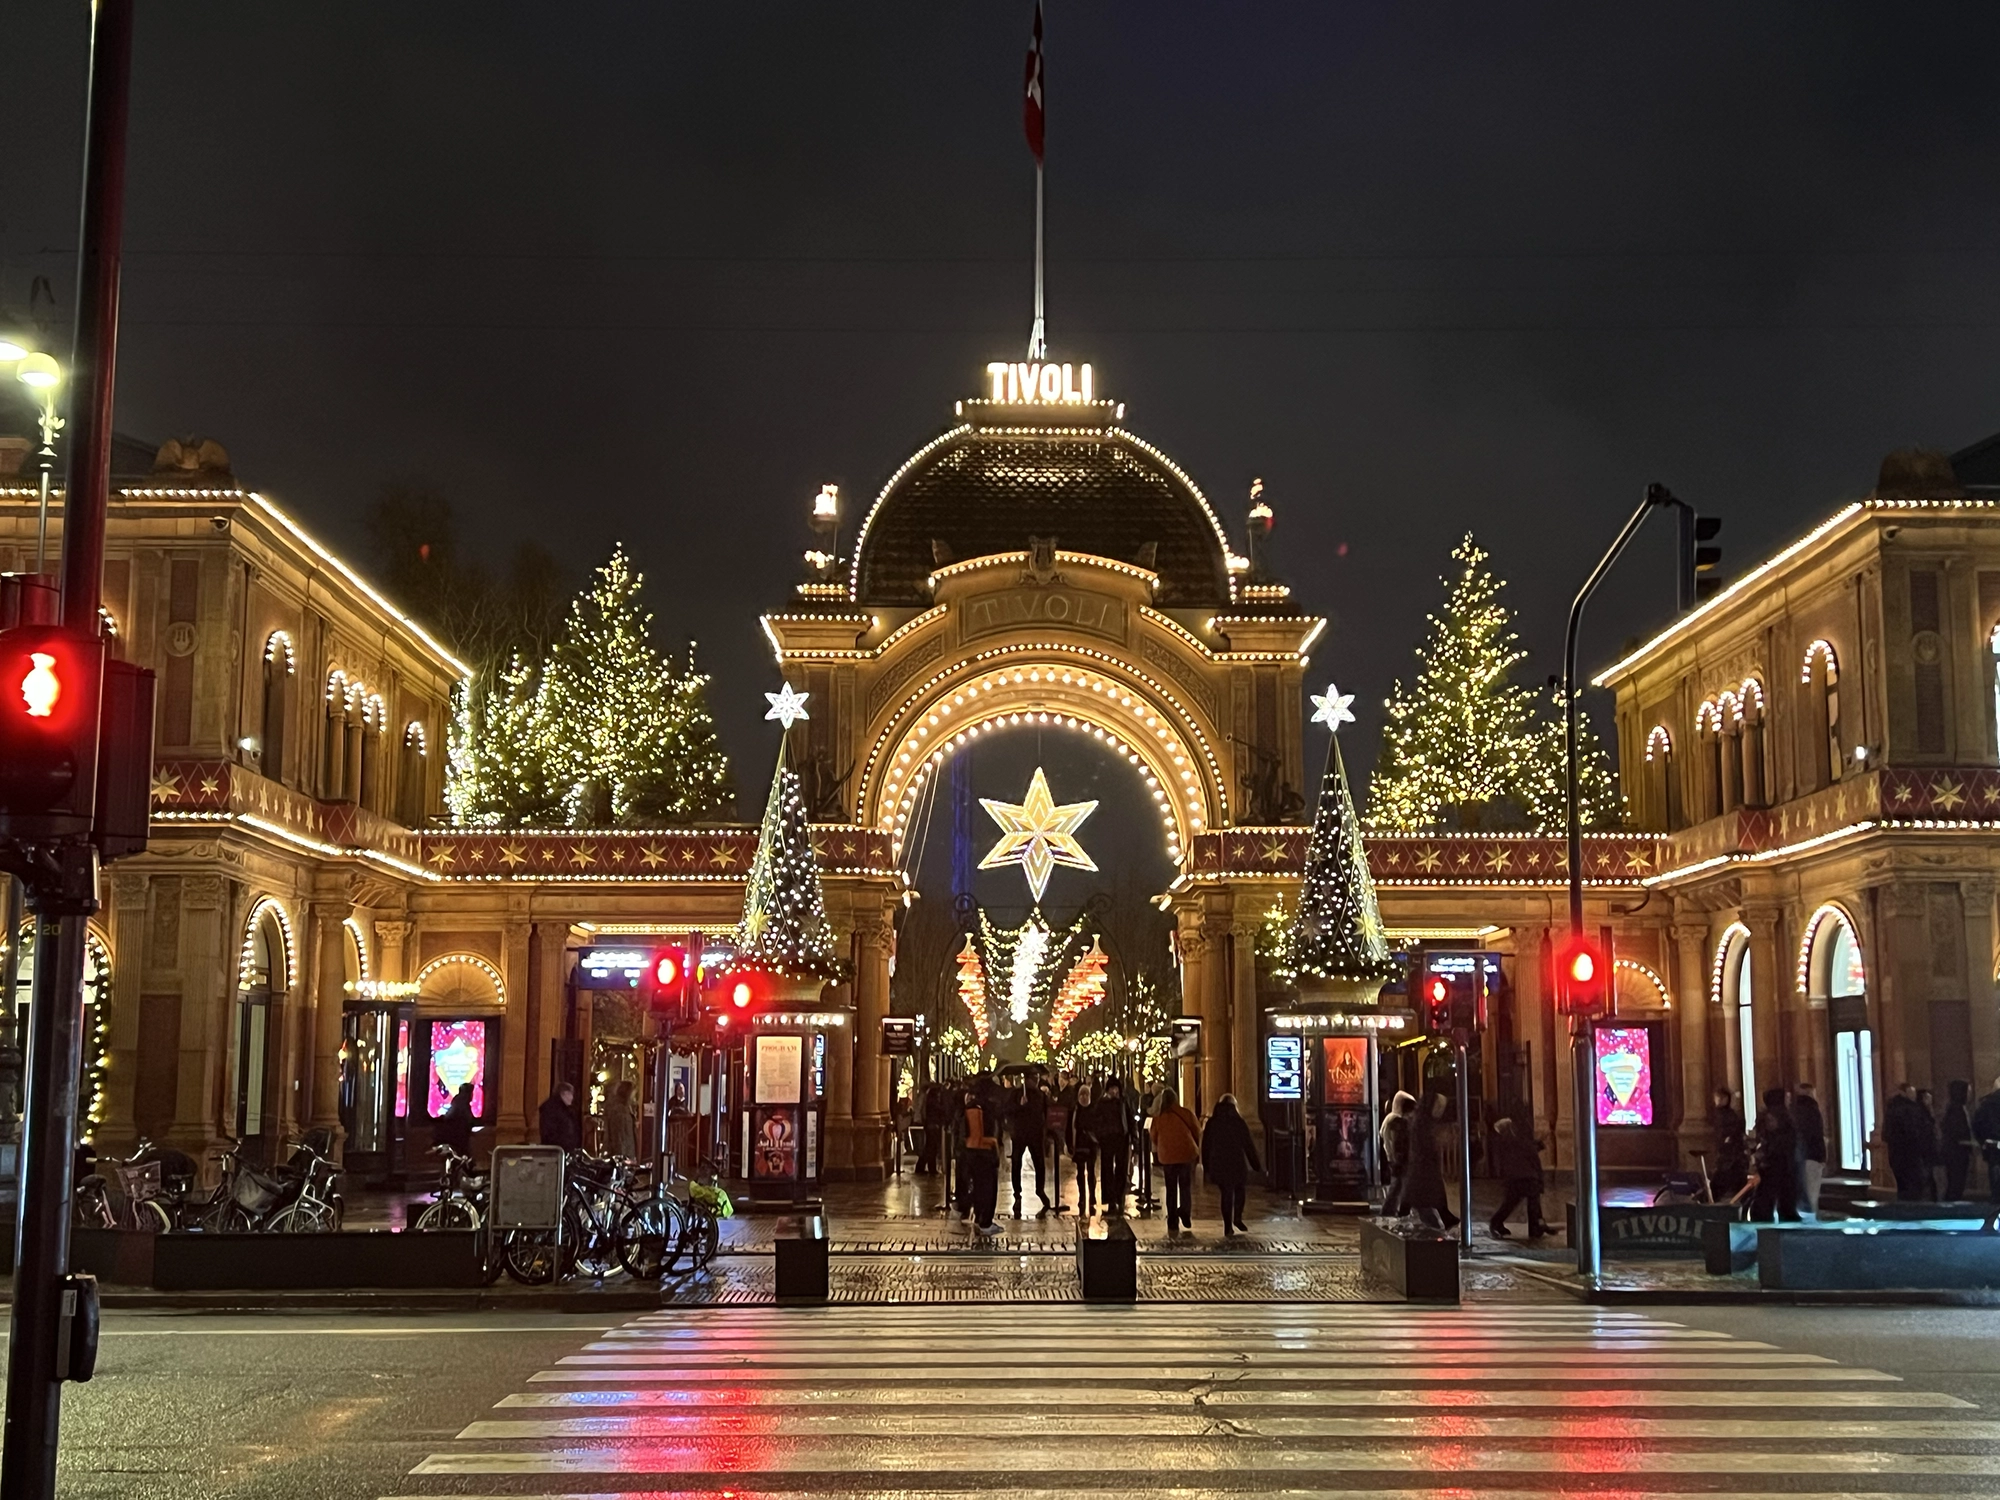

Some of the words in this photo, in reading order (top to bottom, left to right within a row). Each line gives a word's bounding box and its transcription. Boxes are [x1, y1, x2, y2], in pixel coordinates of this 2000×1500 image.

[987, 362, 1093, 403] TIVOLI
[972, 594, 1108, 628] TIVOLI
[1612, 1215, 1704, 1240] TIVOLI
